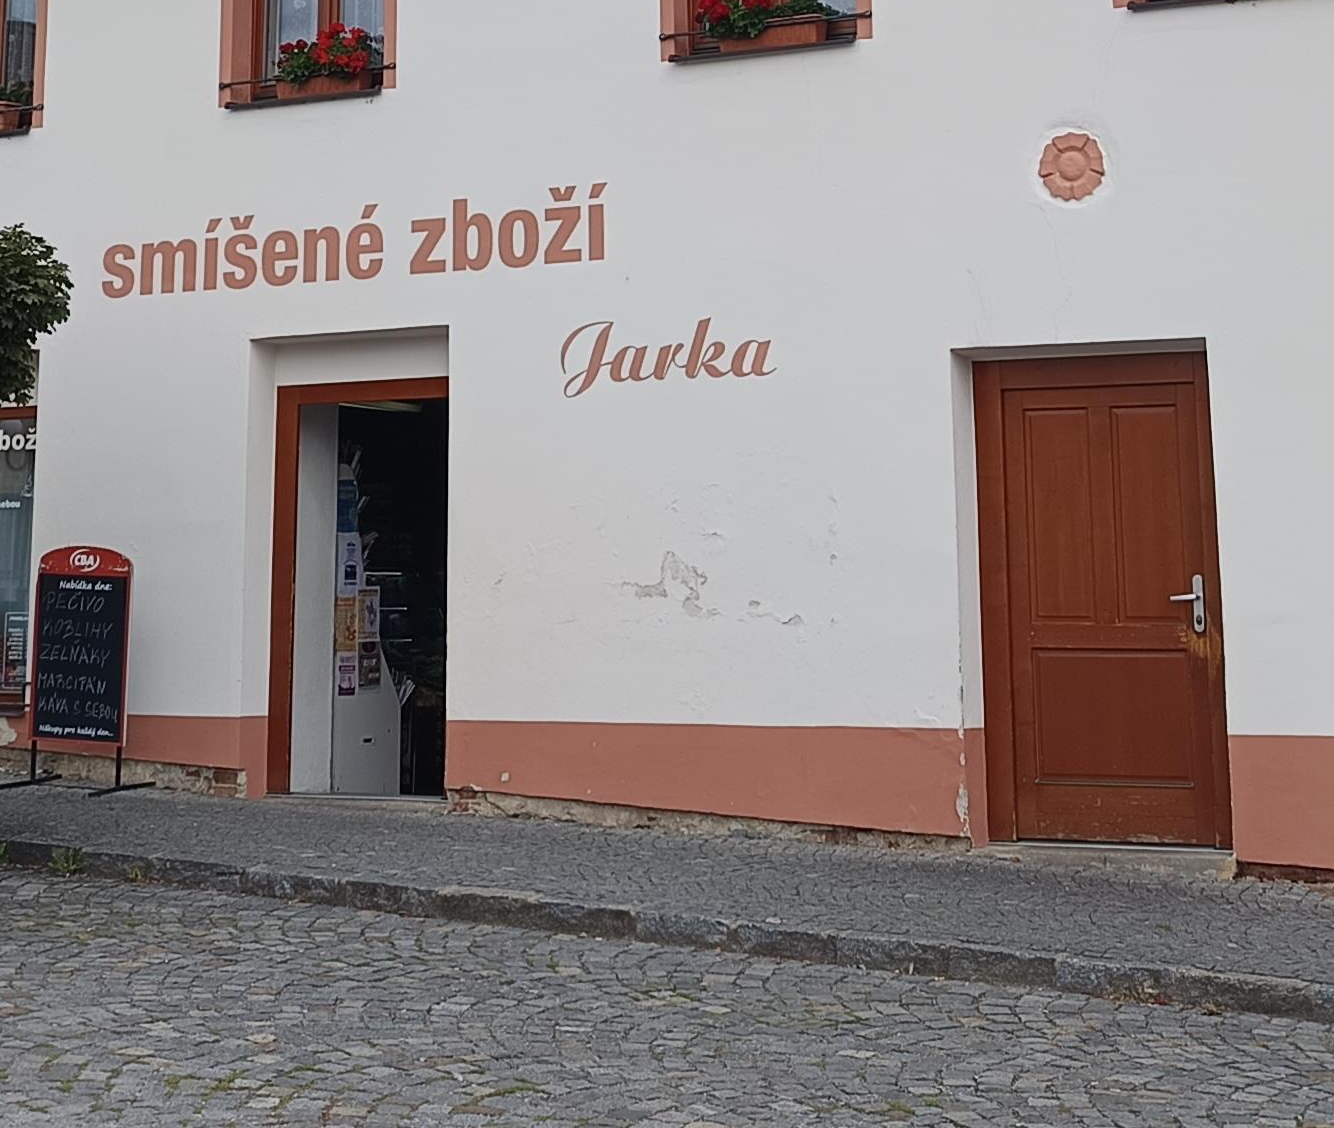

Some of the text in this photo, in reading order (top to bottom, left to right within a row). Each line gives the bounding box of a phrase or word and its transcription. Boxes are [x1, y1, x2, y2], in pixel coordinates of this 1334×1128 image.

[101, 182, 608, 299] smíšené zboží
[560, 317, 777, 398] Jarka
[74, 554, 95, 566] CBA
[59, 579, 113, 591] Nabídka dne:
[45, 591, 105, 613] PEČIVO
[42, 618, 113, 639] KOBLIHY
[37, 672, 106, 694] MARCIPÁN
[37, 692, 118, 723] KÁVA S SEBOU
[63, 727, 76, 736] pro
